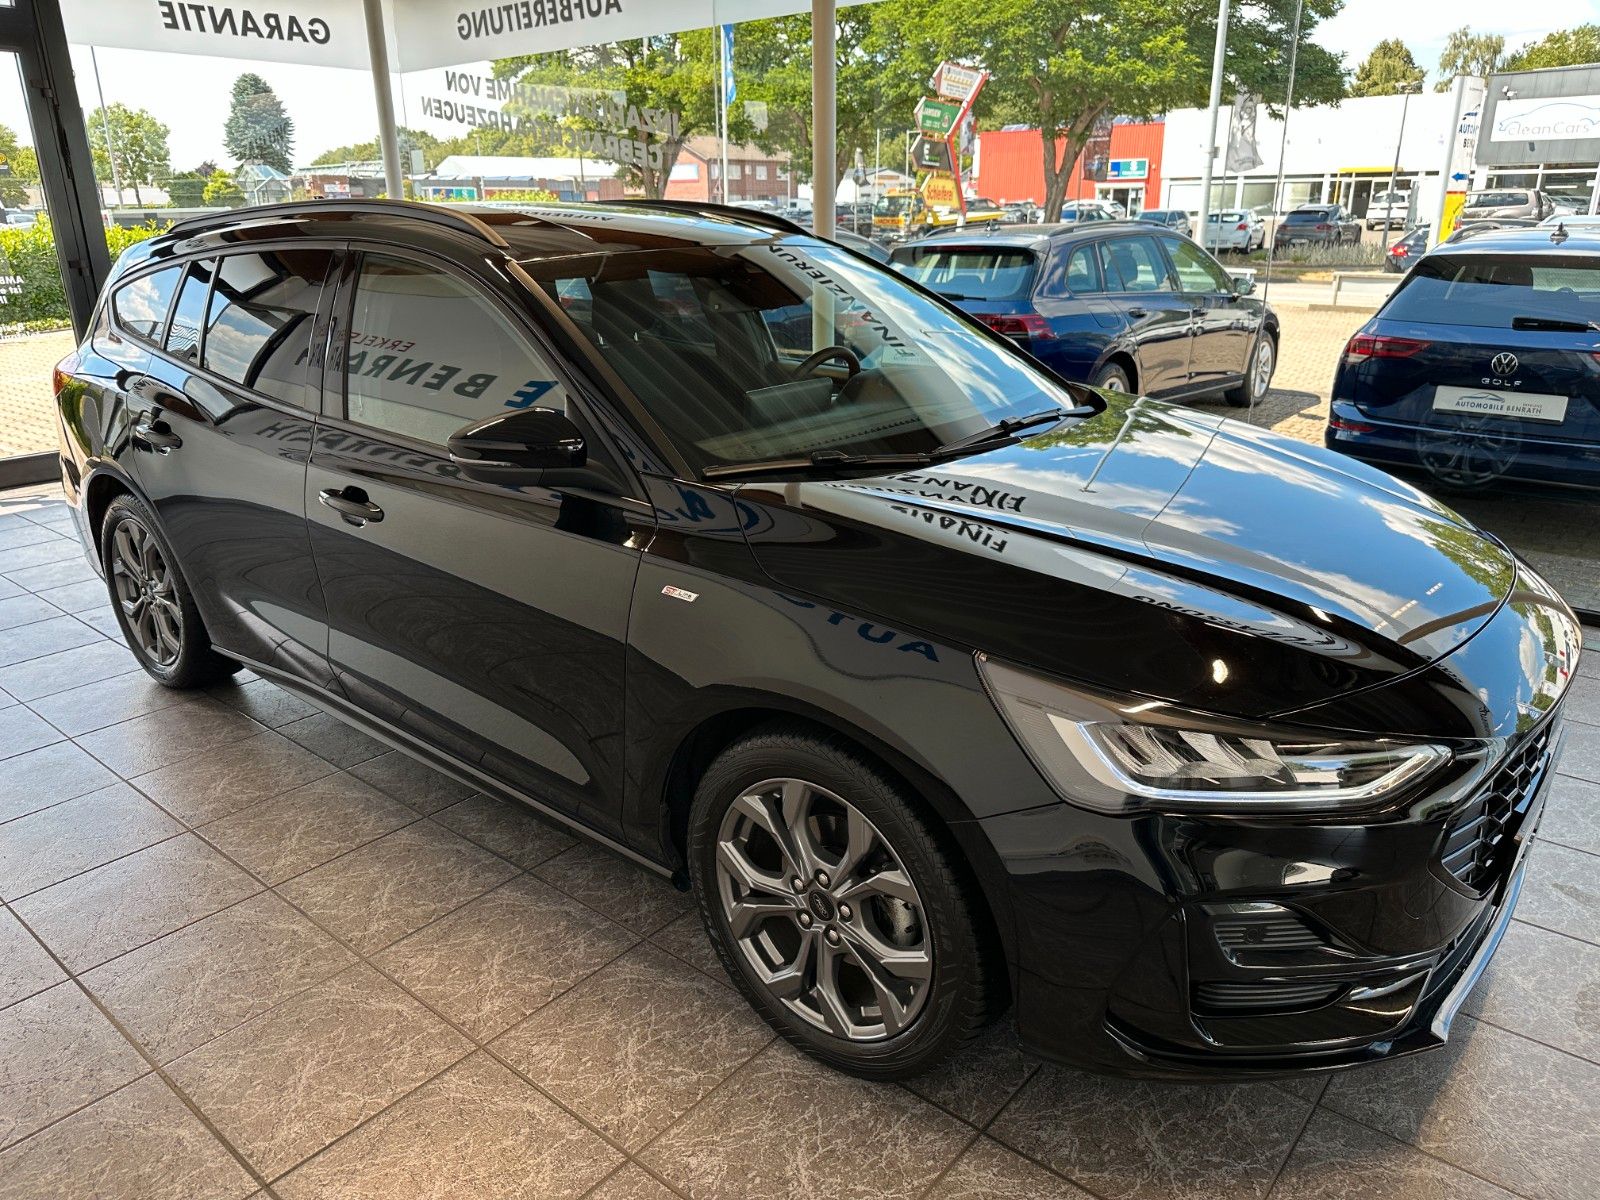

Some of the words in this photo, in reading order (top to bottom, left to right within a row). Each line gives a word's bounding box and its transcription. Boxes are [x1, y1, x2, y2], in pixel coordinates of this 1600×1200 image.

[1481, 377, 1522, 387] GOLF
[1455, 400, 1505, 411] AUTOMOBILE
[1506, 404, 1542, 414] BENRATH
